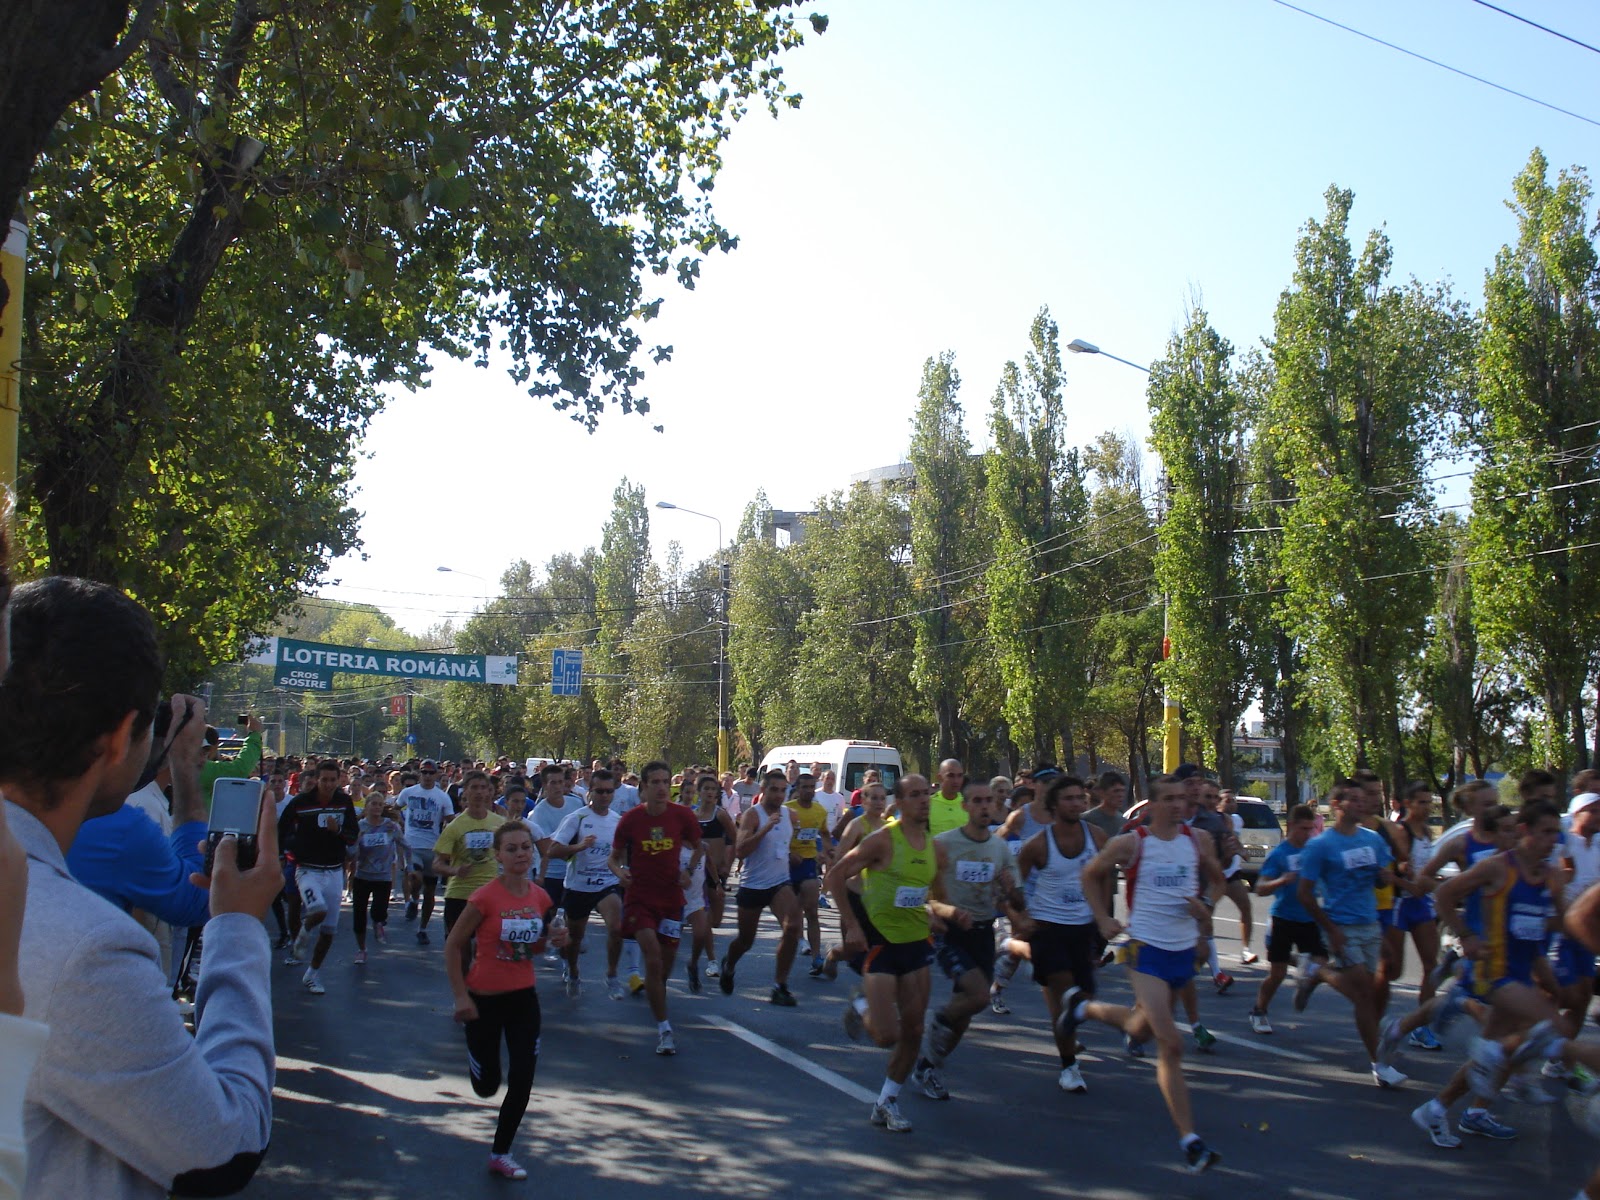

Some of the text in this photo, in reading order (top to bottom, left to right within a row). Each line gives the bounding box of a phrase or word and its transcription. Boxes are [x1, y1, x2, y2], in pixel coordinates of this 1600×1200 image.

[283, 647, 482, 679] LOTERIA ROMÂNĂ
[290, 670, 320, 680] CROS
[280, 676, 328, 690] SOSIRE
[304, 888, 318, 905] R
[508, 930, 538, 942] 0407
